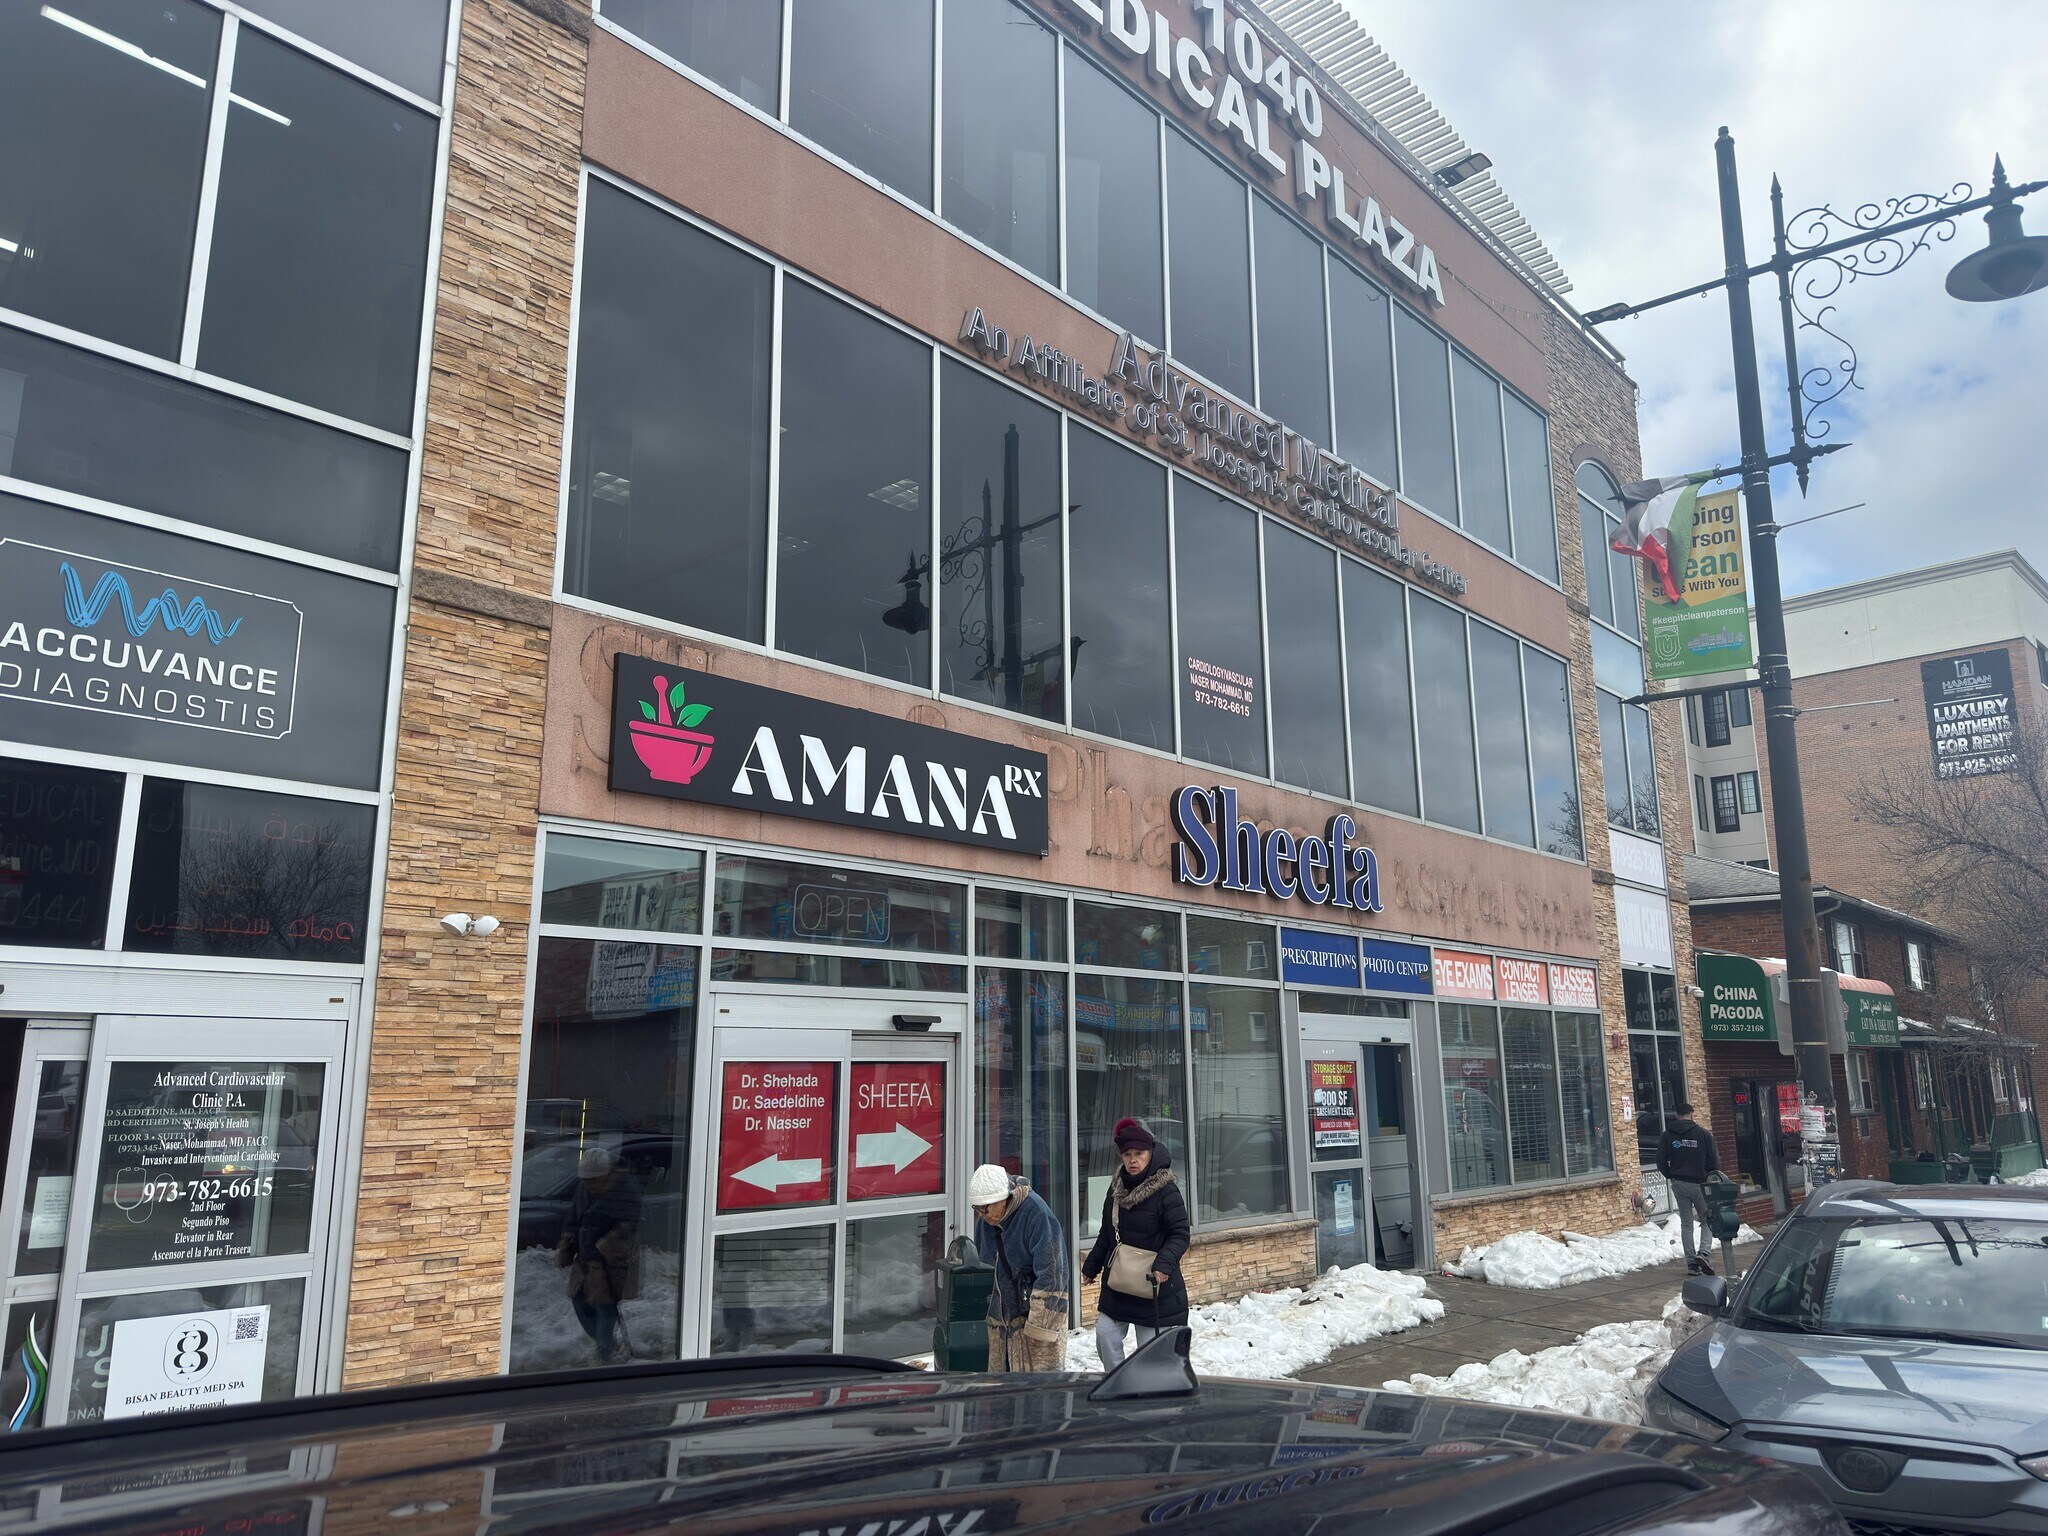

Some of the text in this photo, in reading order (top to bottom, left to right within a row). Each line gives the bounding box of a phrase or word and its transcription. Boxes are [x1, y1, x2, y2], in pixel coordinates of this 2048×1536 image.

[1194, 0, 1324, 138] 1040
[1297, 139, 1445, 310] PLAZA
[1107, 330, 1401, 534] Advanced Medical
[959, 306, 1470, 595] An Affiliate of St. Joseph's Cardiovascular Center
[1689, 578, 1715, 596] With
[1717, 576, 1740, 592] You
[1652, 605, 1745, 628] #keepitcleanpaterson
[0, 621, 278, 696] ACCUVANCE
[1655, 659, 1685, 673] Paterson
[1190, 672, 1210, 690] NASER
[1244, 690, 1253, 703] MD
[1942, 674, 1992, 690] HAMDAN
[0, 661, 276, 730] DIAGNOSTIS
[1194, 690, 1251, 717] 973-782-6615
[1933, 698, 2009, 722] LUXURY
[1935, 715, 2011, 740] APARTMENTS
[1936, 731, 2013, 756] FOR RENT
[731, 725, 1018, 840] AMANA
[1003, 763, 1042, 799] RX
[1170, 782, 1385, 915] Sheefa
[800, 892, 886, 936] OPEN
[1281, 946, 1358, 971] PRESCRIPTIONS
[1363, 955, 1395, 976] PHOTO
[1434, 958, 1494, 992] EYE EXAMS
[1500, 958, 1541, 983] CONTACT
[1551, 964, 1595, 990] GLASSES
[1505, 978, 1540, 1003] LENSES
[1713, 983, 1757, 1001] CHINA
[1709, 1003, 1764, 1021] PAGODA
[1710, 1023, 1765, 1034] (973) 357-2168
[1313, 1063, 1353, 1075] STORAGE SPACE
[153, 1070, 287, 1087] Advanced Cardiovascular
[741, 1072, 819, 1089] Dr. Shehada
[1322, 1075, 1346, 1086] FOR RENT
[192, 1092, 246, 1108] Clinic P.A.
[732, 1093, 826, 1110] Dr. Saedeldine
[858, 1082, 933, 1111] SHEEFA
[1338, 1090, 1349, 1107] SF
[1734, 1093, 1748, 1105] OPEN
[115, 1107, 178, 1118] SAEDELDINE,
[179, 1107, 196, 1116] MD,
[1341, 1106, 1355, 1118] LEVEL
[122, 1118, 170, 1127] CERTIFIED
[183, 1117, 250, 1132] St. Joseph's Health
[744, 1116, 812, 1132] Dr. Nasser
[108, 1133, 142, 1142] FLOOR
[143, 1133, 150, 1141] 3
[157, 1131, 187, 1141] SUITE
[183, 1137, 228, 1149] Mohammad,
[229, 1136, 245, 1147] MD,
[246, 1135, 269, 1147] FACC
[118, 1144, 141, 1154] (973)
[141, 1154, 173, 1167] Invasive
[173, 1153, 188, 1165] and
[189, 1151, 240, 1164] Interventional
[143, 1175, 274, 1204] 973-782-6615
[189, 1200, 226, 1212] 2nd Floor
[181, 1215, 230, 1229] Segundo Piso
[174, 1230, 234, 1244] Elevator in Rear
[151, 1244, 252, 1261] Ascensor el la Parte Trasera
[124, 1379, 245, 1406] BISAN BEAUTY MED SPA
[167, 1403, 187, 1415] Hair
